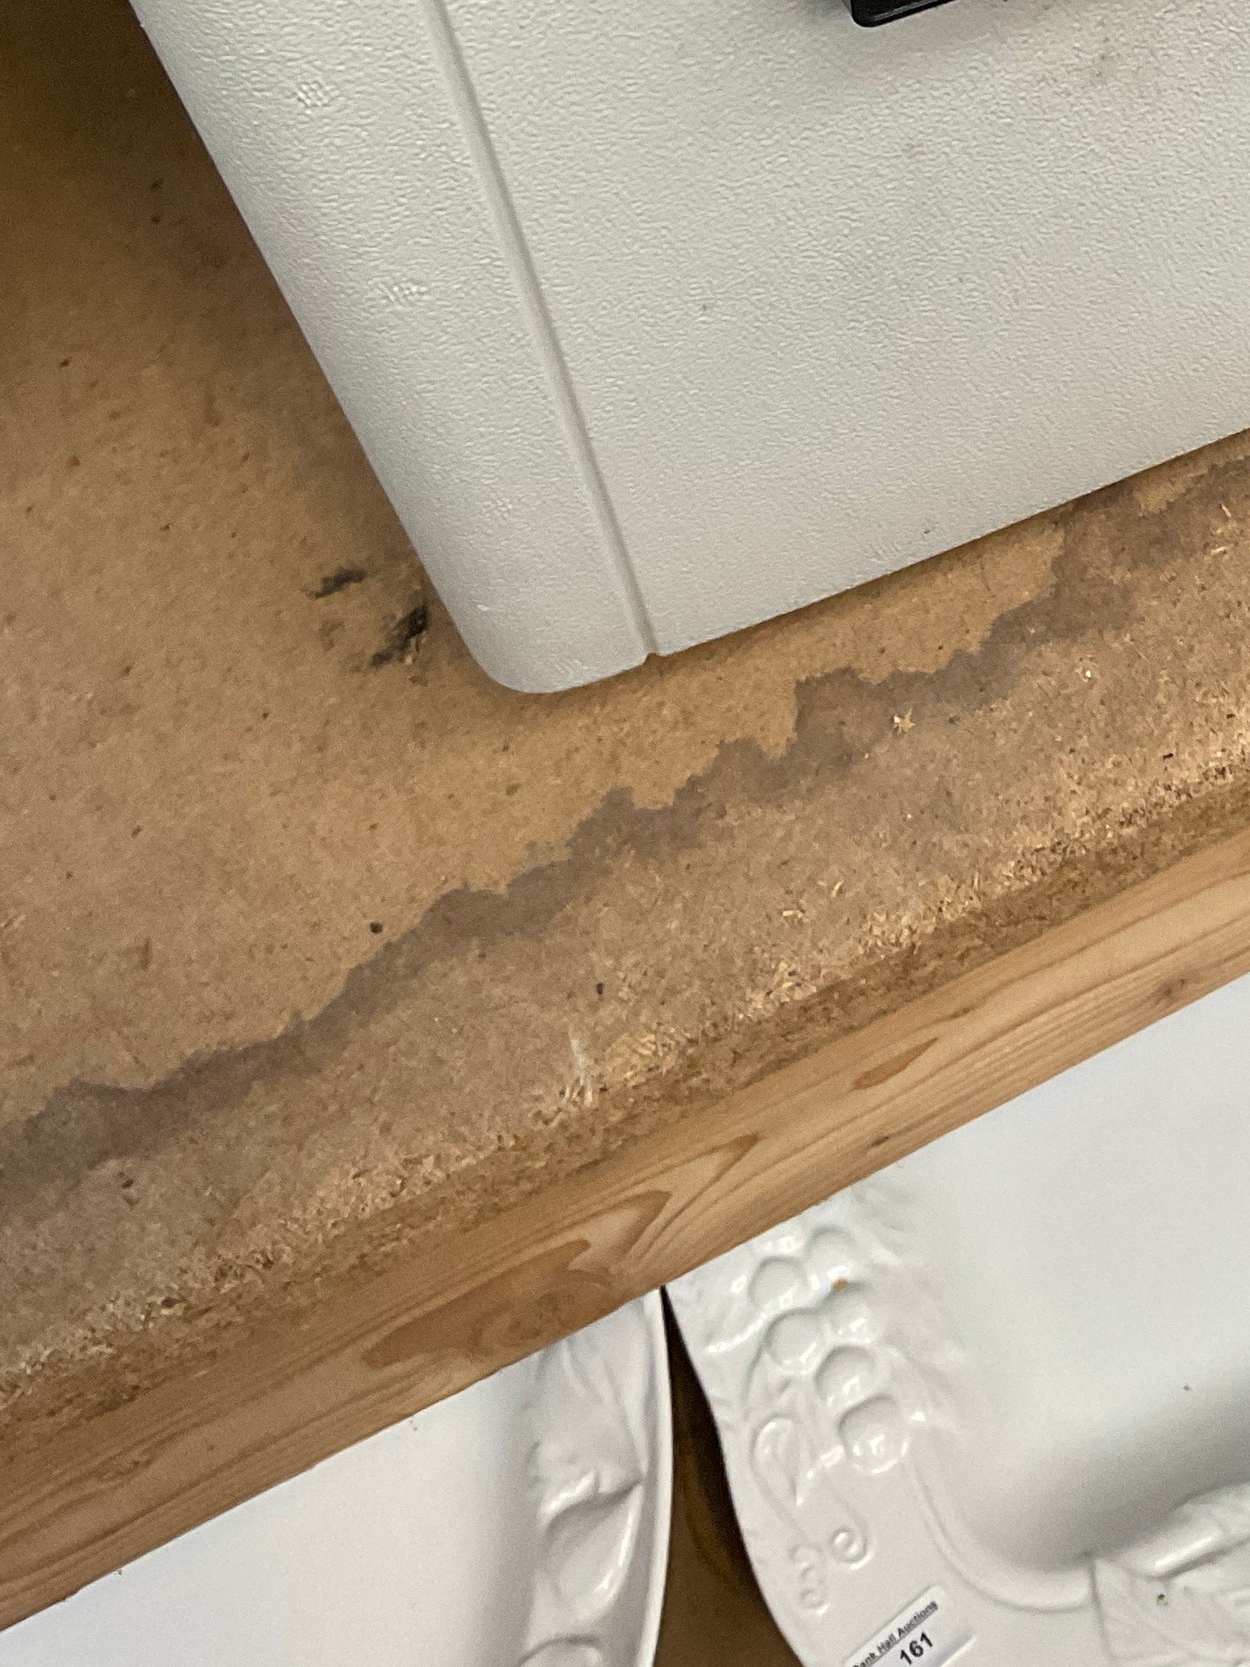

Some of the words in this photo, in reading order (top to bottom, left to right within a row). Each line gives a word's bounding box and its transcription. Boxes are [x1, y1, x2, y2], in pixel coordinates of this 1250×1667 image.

[876, 1633, 897, 1654] Hall
[897, 1601, 938, 1638] Auctions
[900, 1631, 933, 1665] 161
